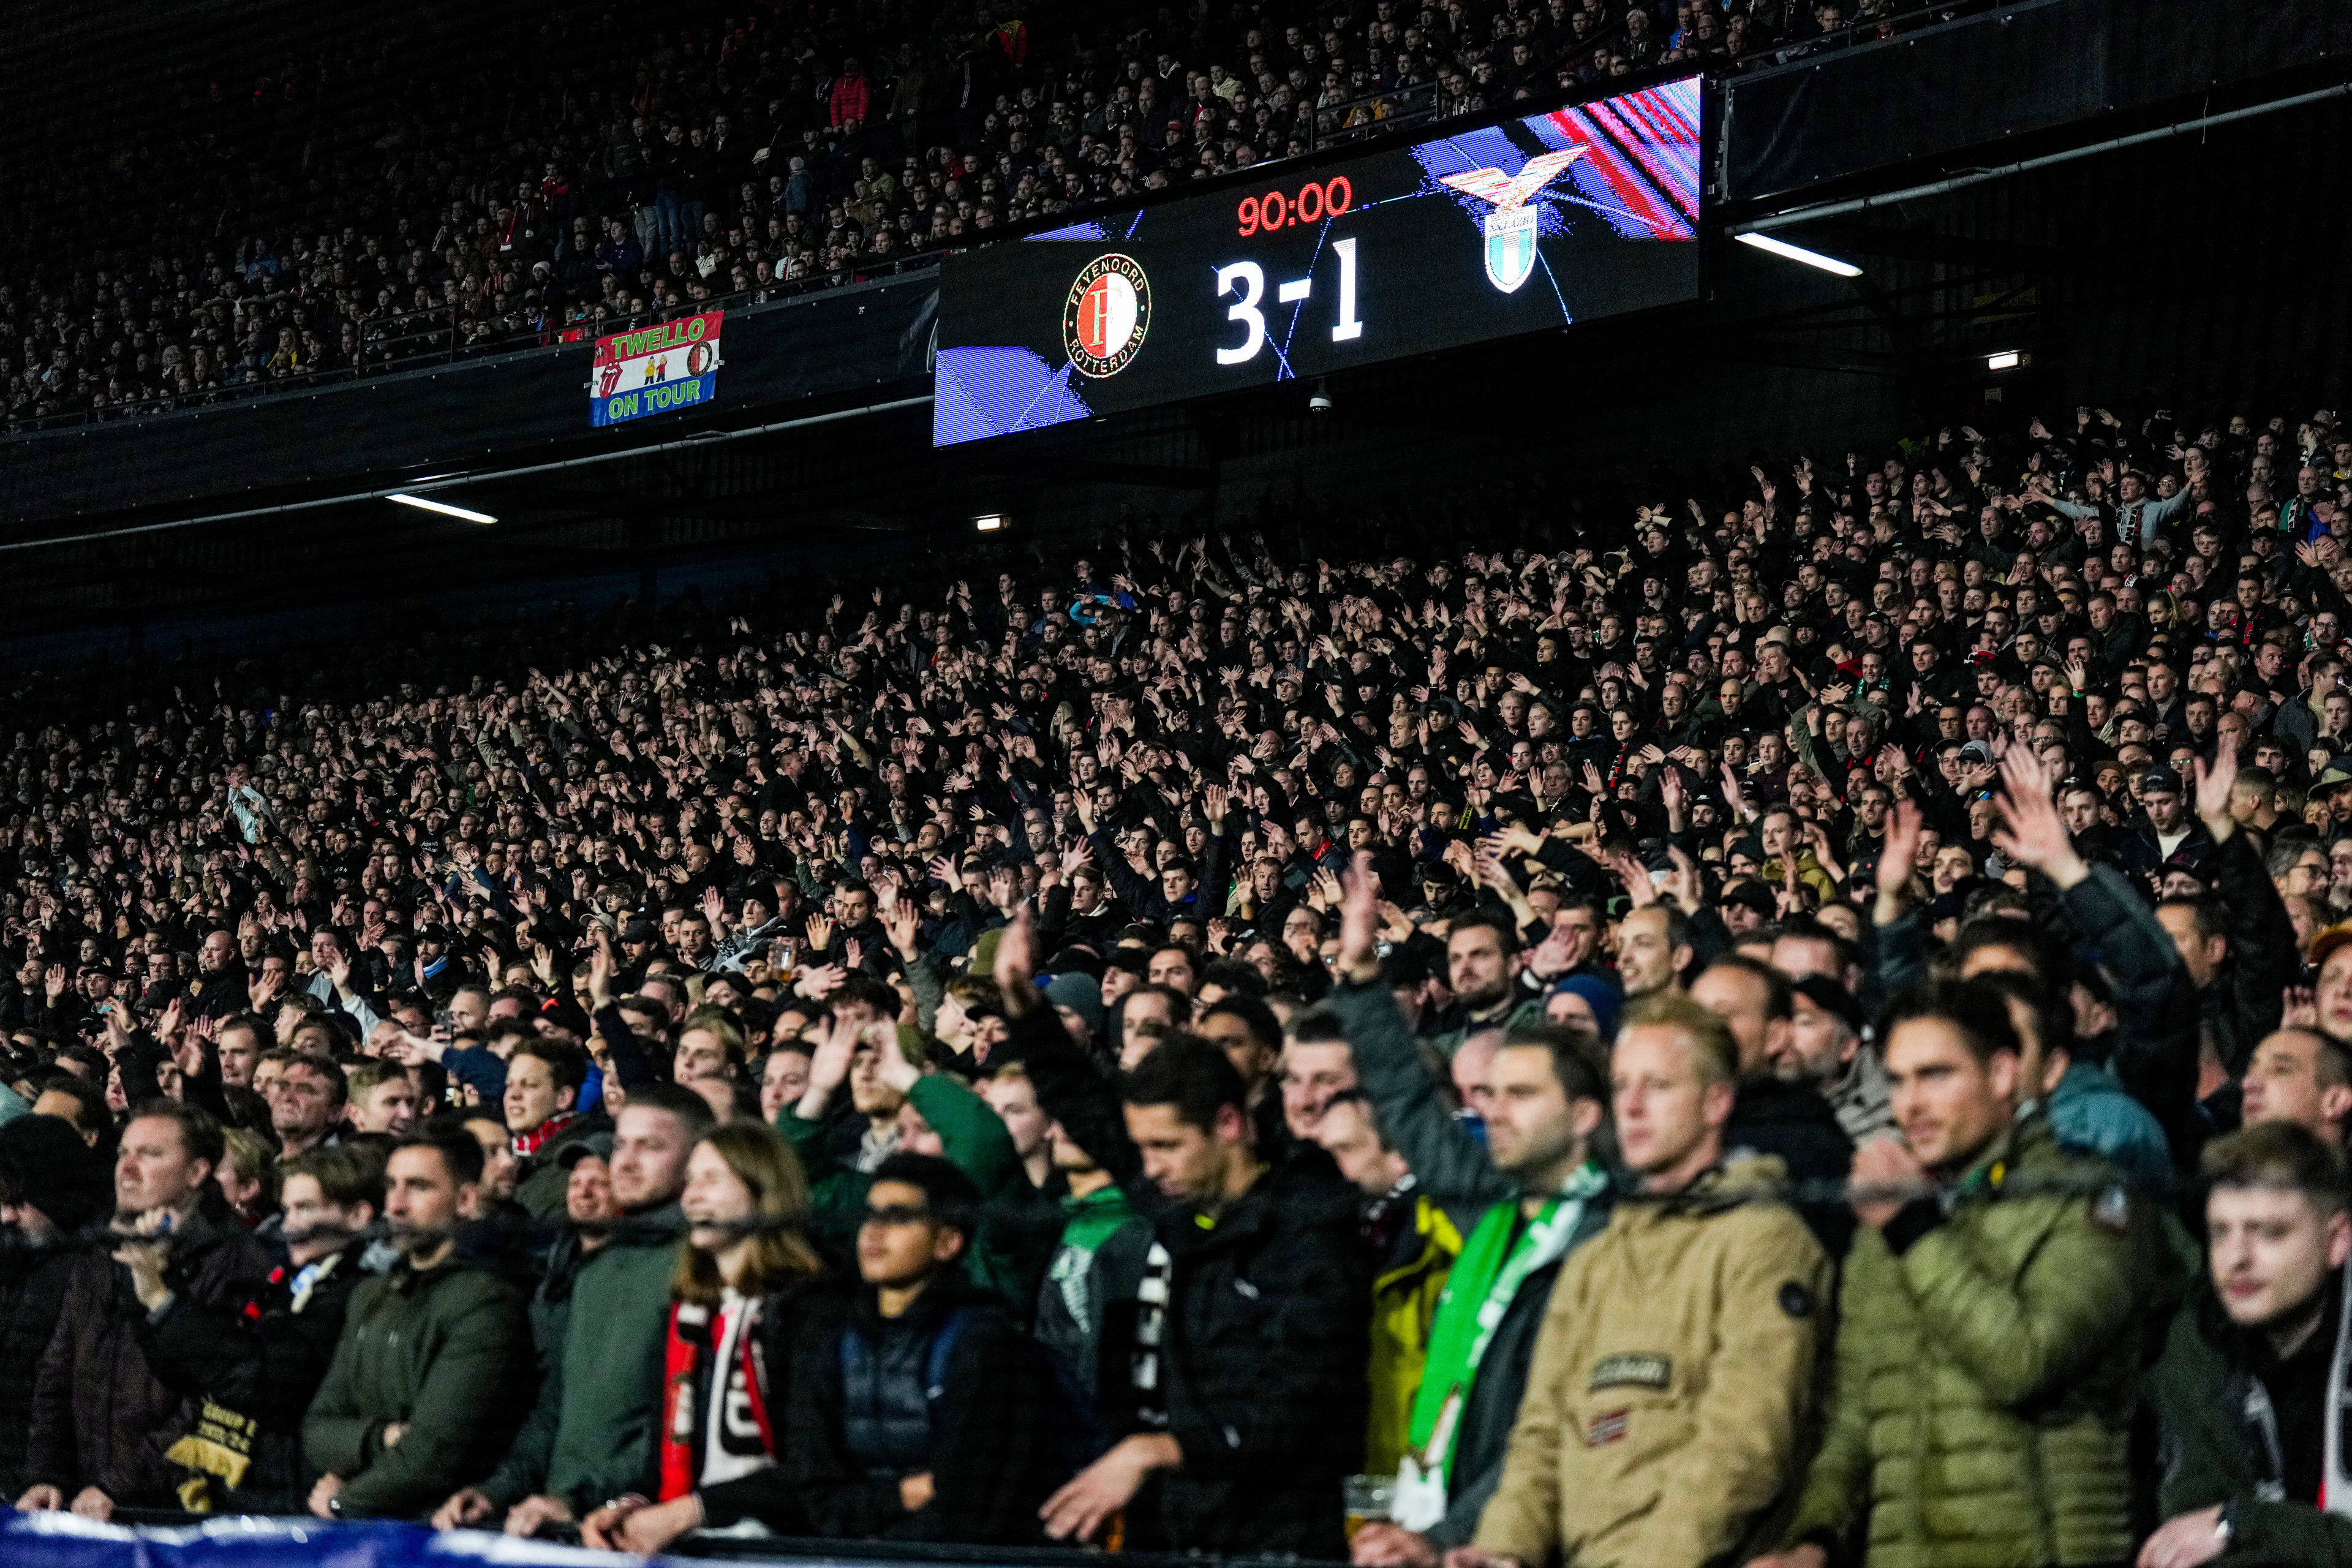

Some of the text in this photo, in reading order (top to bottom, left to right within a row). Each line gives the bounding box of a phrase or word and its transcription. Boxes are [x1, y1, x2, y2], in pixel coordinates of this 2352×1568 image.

[1238, 176, 1352, 236] 90:00
[1070, 257, 1145, 306] FEYENOORD
[611, 318, 705, 360] TWELLO
[1069, 325, 1144, 372] ROTTERDAM
[608, 379, 701, 419] ON TOUR
